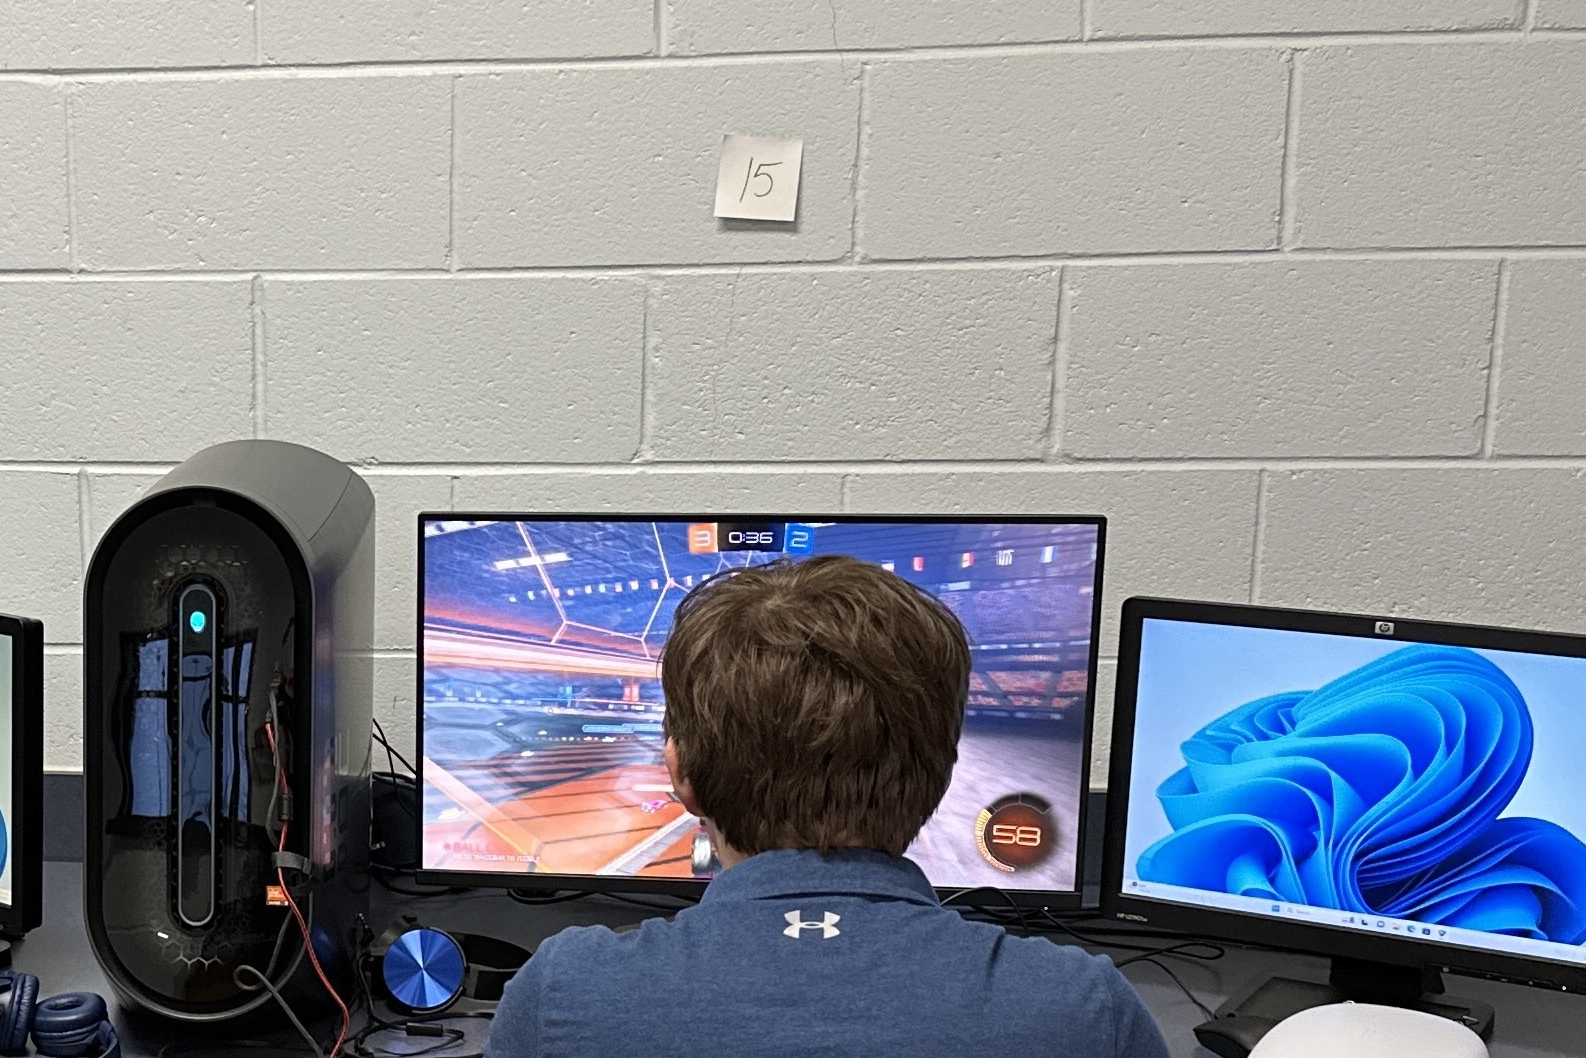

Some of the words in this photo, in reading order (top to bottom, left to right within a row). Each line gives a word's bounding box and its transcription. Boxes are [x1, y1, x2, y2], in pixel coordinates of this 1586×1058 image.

[739, 158, 783, 204] 15
[695, 531, 710, 547] 3
[728, 531, 774, 544] 0:36
[790, 531, 808, 547] 2
[992, 824, 1041, 847] 58
